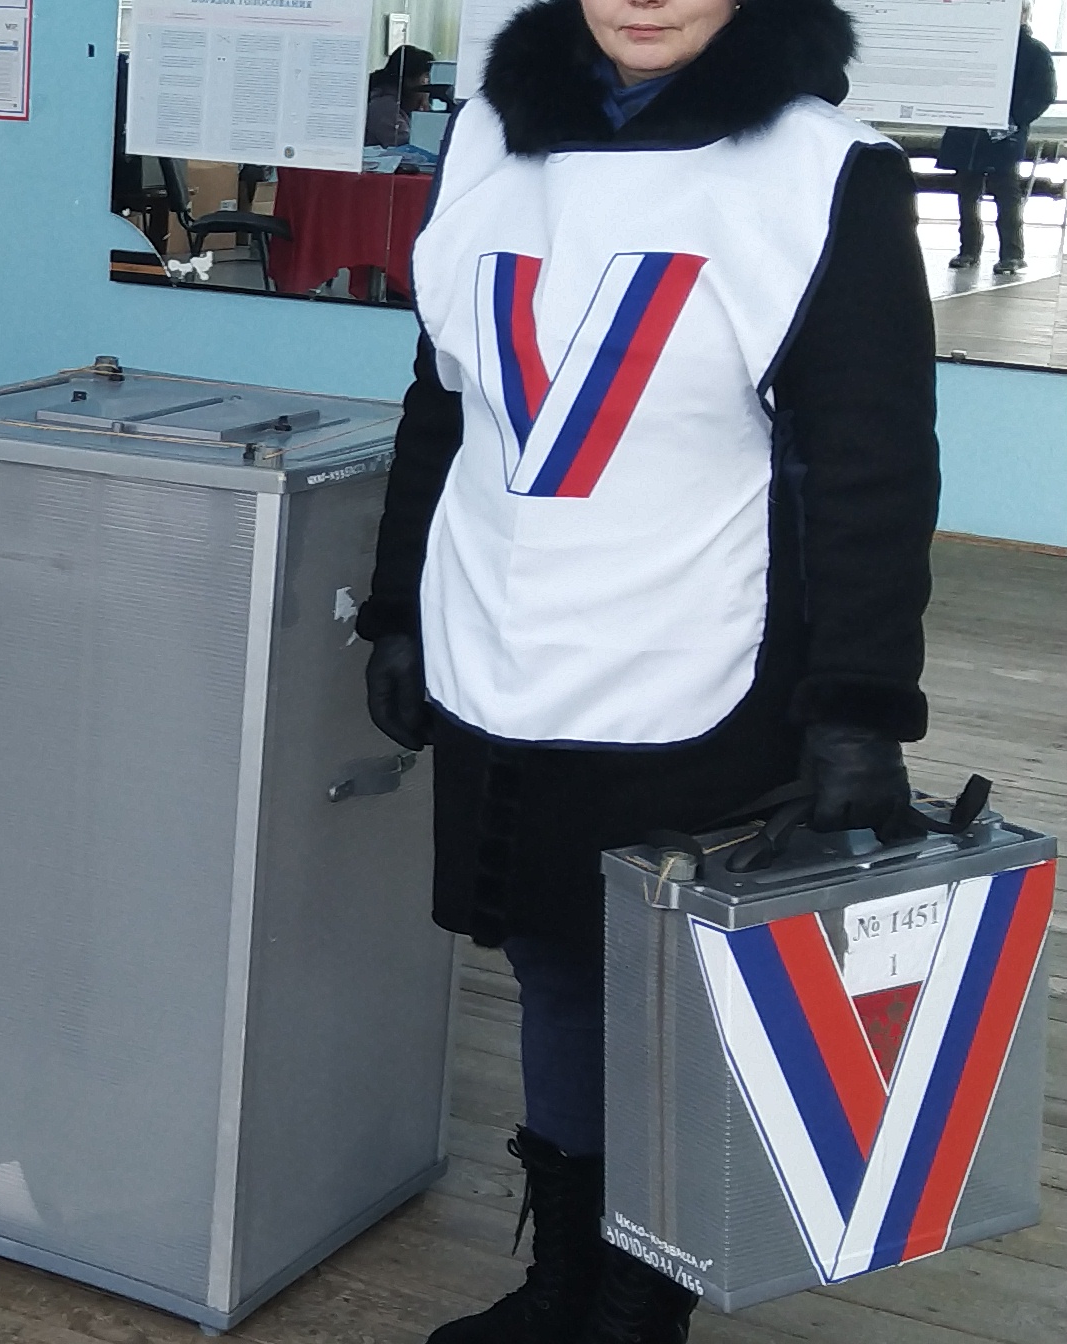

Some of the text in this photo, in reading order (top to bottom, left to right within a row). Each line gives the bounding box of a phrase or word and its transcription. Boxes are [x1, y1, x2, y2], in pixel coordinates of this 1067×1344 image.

[853, 901, 939, 941] № 1451
[889, 953, 898, 977] 1
